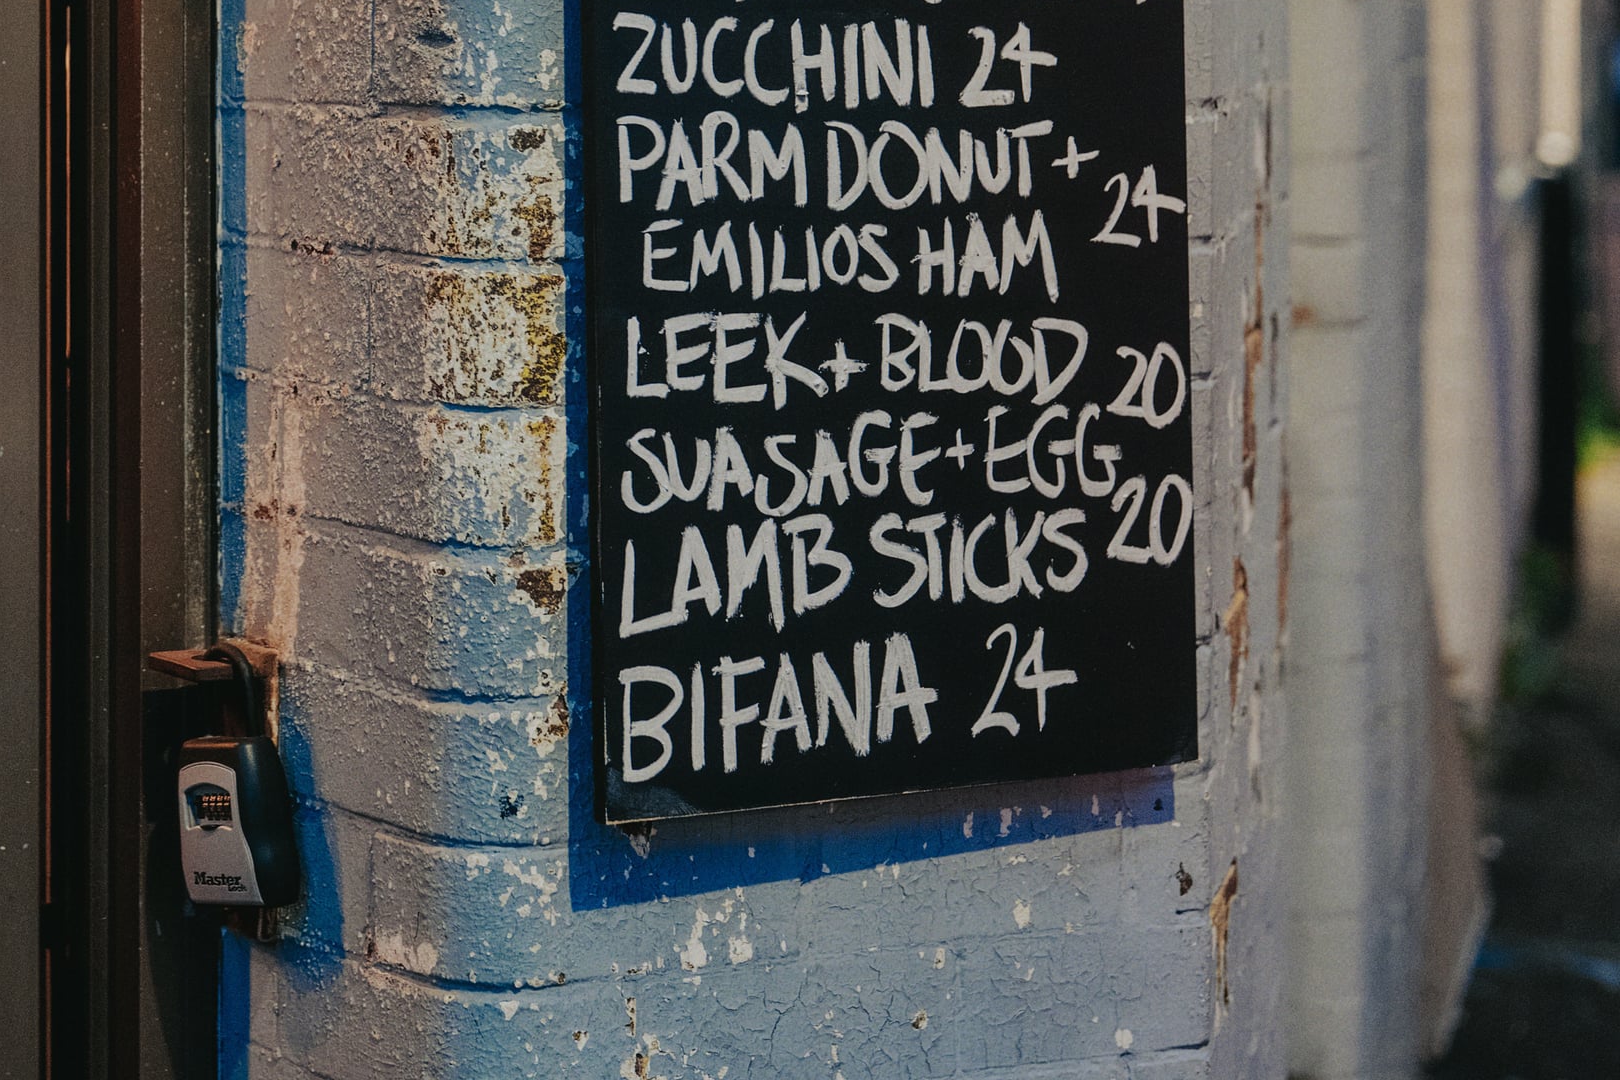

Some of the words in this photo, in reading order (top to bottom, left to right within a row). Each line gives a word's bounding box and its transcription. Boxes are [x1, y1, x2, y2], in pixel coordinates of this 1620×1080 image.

[613, 12, 934, 112] ZUCCHINI
[959, 22, 1057, 107] 24
[616, 111, 807, 210] PARM
[1091, 165, 1186, 247] 24
[642, 219, 899, 299] EMILIOS
[910, 210, 1058, 303] HAM
[875, 313, 1088, 405] BLOOD
[1107, 342, 1185, 429] 20
[620, 512, 854, 638] LAMB
[870, 508, 1088, 607] STICKS
[1105, 472, 1194, 564] 20
[618, 631, 937, 782] BIFANA
[971, 624, 1077, 737] 24
[194, 872, 242, 886] Master
